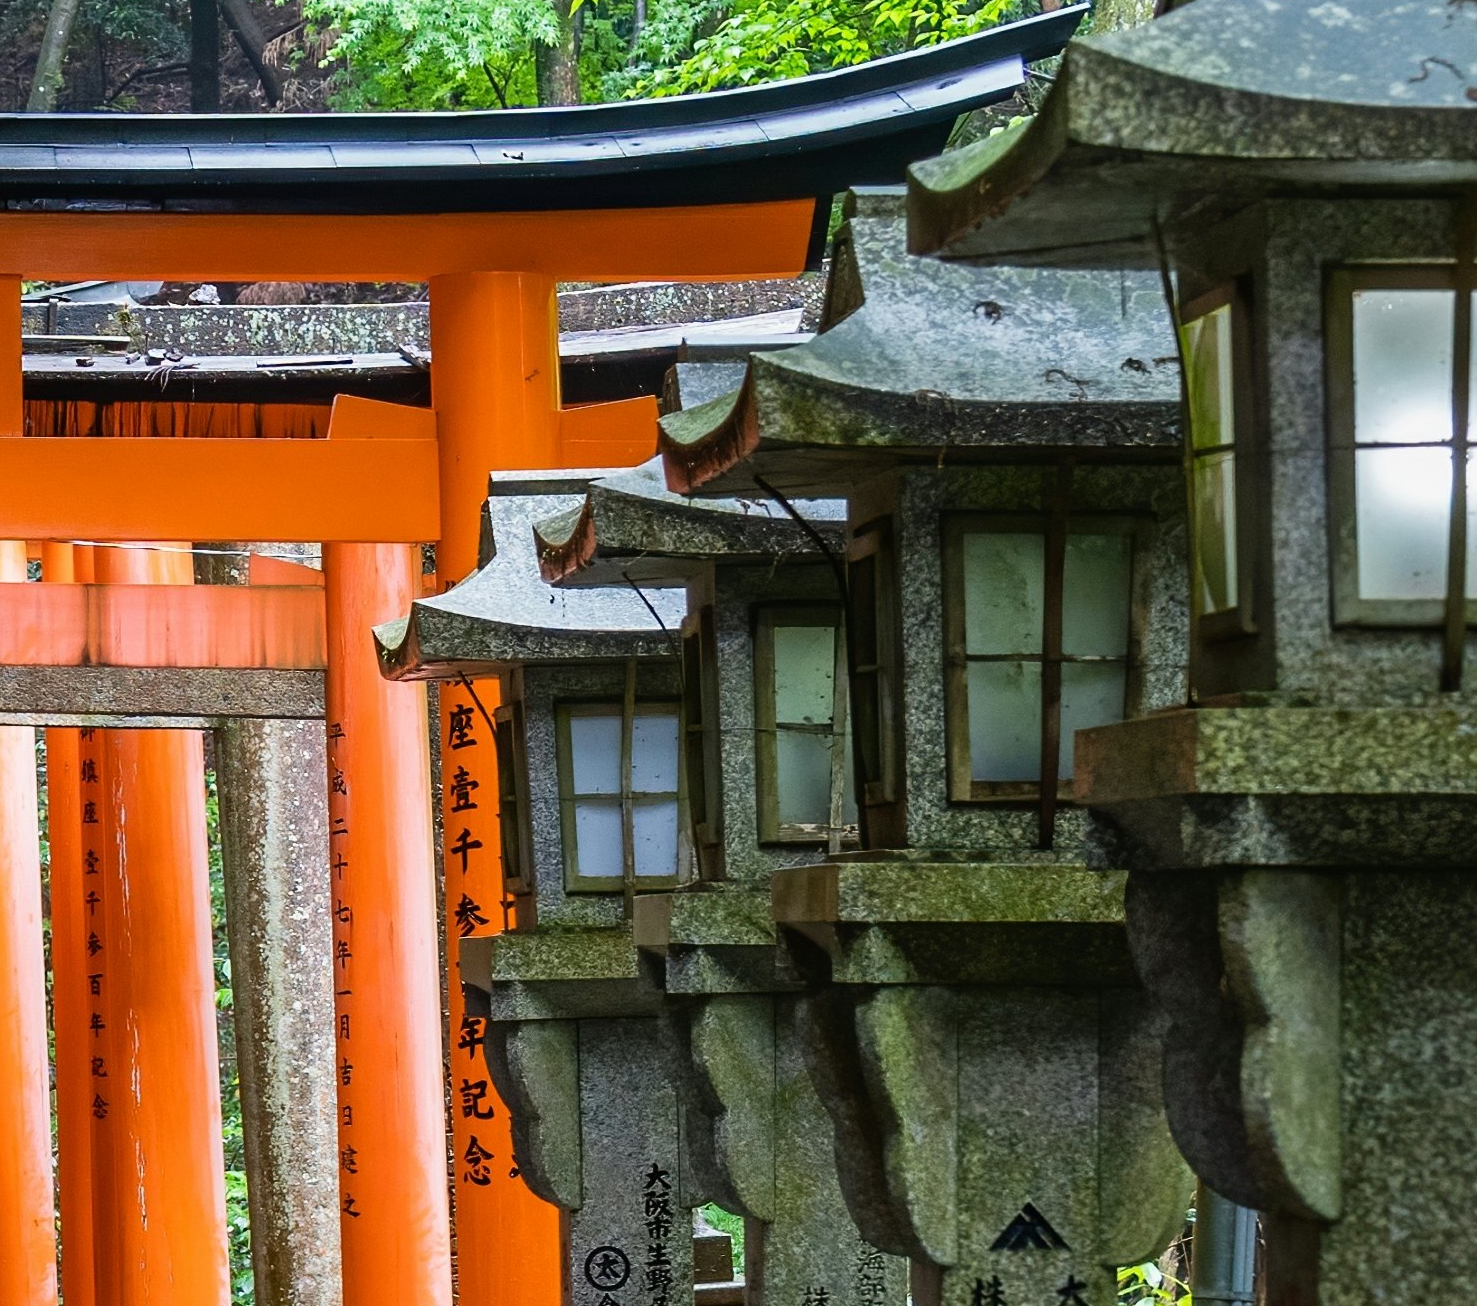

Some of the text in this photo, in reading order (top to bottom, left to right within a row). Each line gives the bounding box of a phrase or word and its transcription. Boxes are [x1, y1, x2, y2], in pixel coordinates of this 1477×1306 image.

[328, 721, 361, 1219] 平成二十七年一月吉日建之
